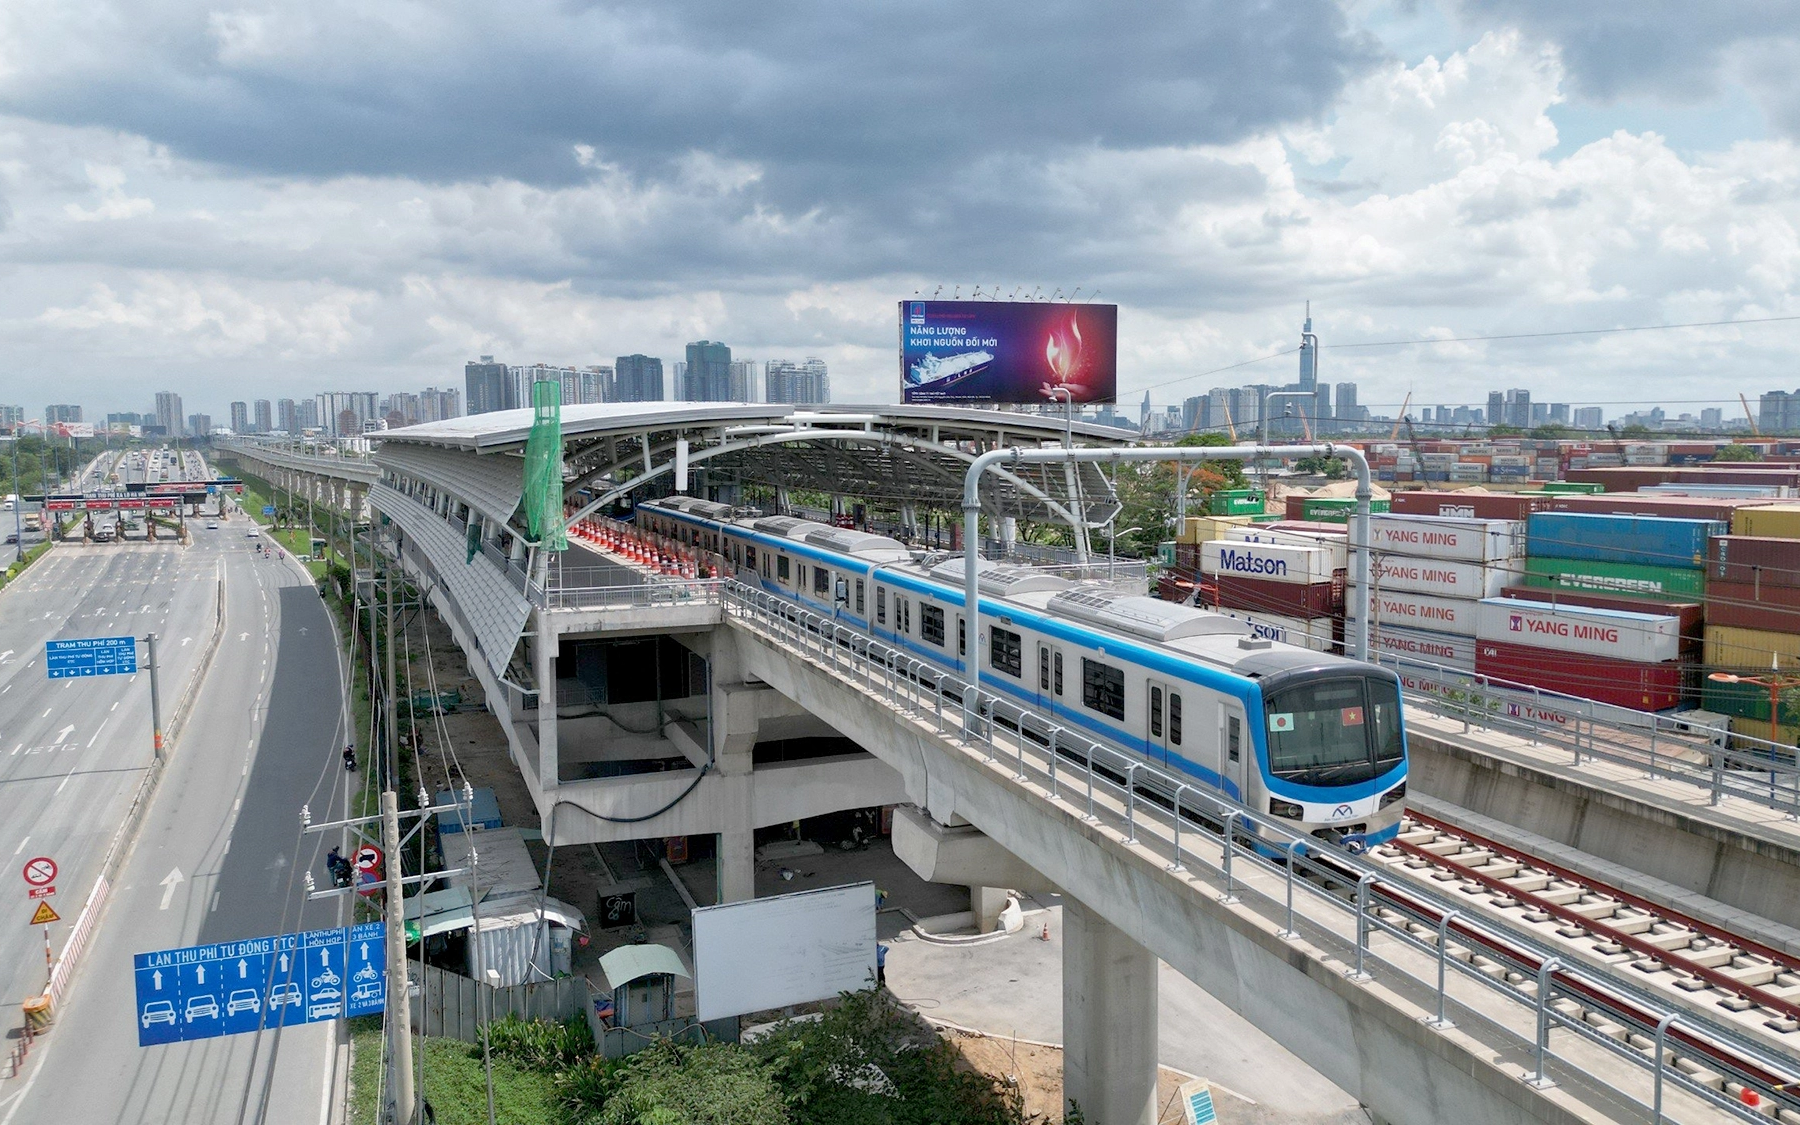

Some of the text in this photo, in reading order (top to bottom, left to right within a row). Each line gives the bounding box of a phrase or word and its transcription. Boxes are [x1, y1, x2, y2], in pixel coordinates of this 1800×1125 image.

[936, 326, 967, 337] LƯỢNG
[1439, 504, 1475, 518] HMM
[1385, 529, 1457, 546] YANG MING
[1220, 549, 1286, 576] Matson
[1385, 565, 1456, 584] YANG MING
[1560, 573, 1662, 593] EVERGREEN
[1384, 601, 1454, 621] YANG MING
[1526, 618, 1618, 643] YANG MING
[1383, 636, 1454, 658] YANG MING
[148, 951, 171, 967] LÀN
[174, 950, 197, 964] THU
[199, 943, 219, 960] PHÍ
